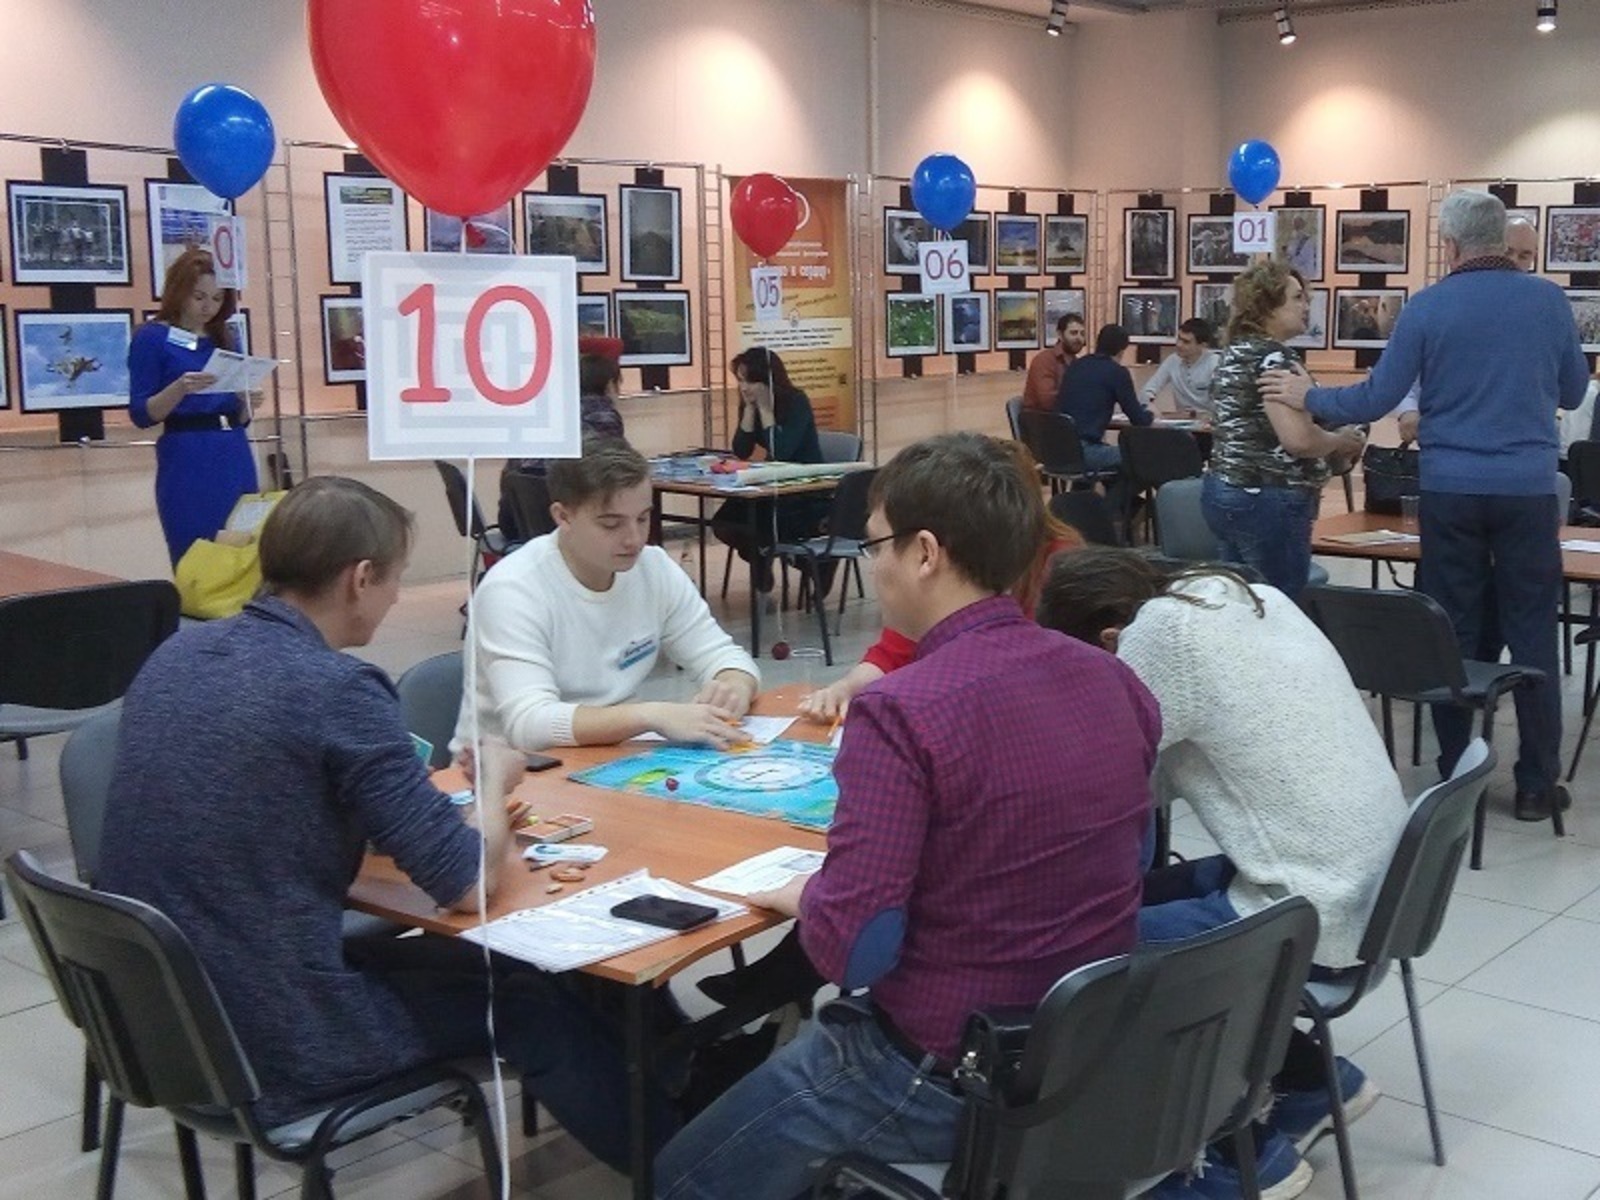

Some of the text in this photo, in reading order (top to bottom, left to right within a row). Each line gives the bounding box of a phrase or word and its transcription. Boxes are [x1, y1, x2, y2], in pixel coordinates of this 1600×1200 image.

[1239, 218, 1268, 242] 01
[925, 248, 965, 281] 06
[758, 275, 780, 308] 05
[397, 283, 553, 407] 10
